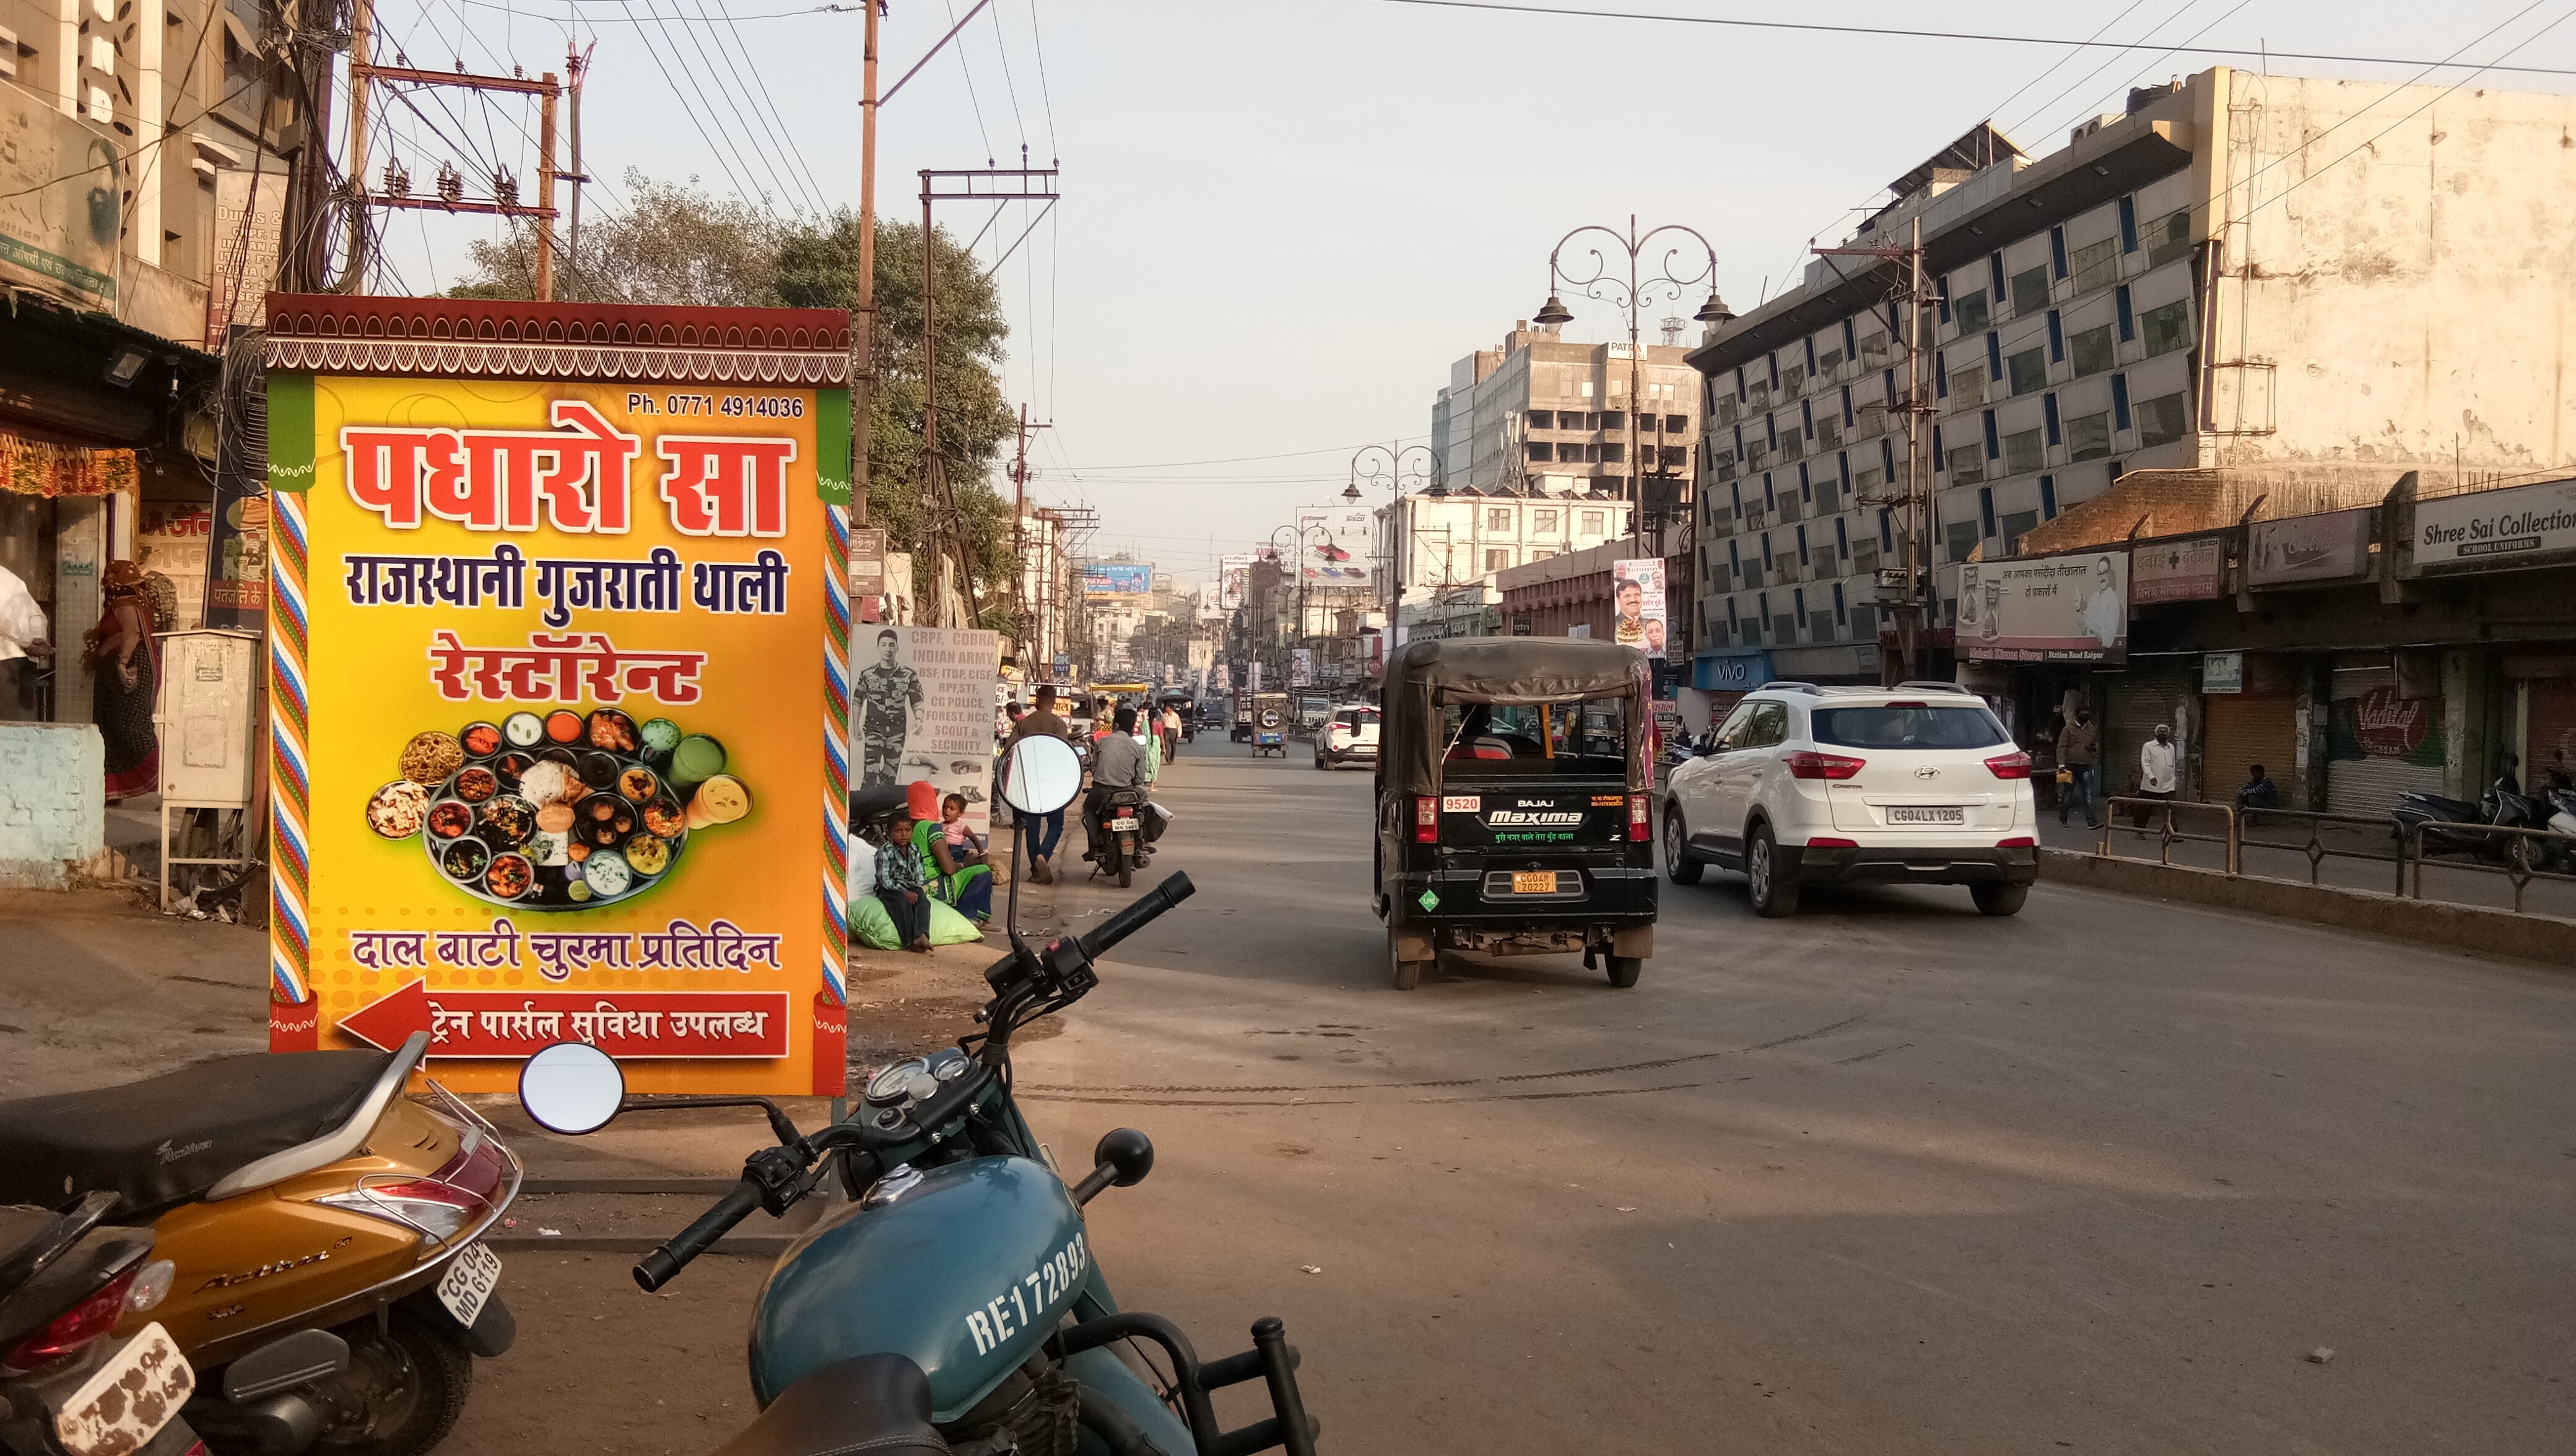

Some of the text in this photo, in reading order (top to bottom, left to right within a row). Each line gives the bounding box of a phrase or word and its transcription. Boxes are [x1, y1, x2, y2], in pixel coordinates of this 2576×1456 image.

[627, 392, 804, 418] Ph. 0771 4914036
[341, 400, 797, 537] पधारो सा
[2424, 524, 2465, 546] Shree
[2469, 518, 2494, 540] Sai
[2463, 538, 2535, 555] SCHOOL UNIFORMS
[2003, 564, 2087, 579] अब आपका पसंदीदा तीखालाल
[344, 544, 527, 609] राजस्थानी
[536, 545, 684, 629] गुजराती
[692, 548, 790, 615] थाली
[2025, 587, 2031, 598] दो
[2032, 584, 2051, 597] प्रकारों
[911, 630, 998, 648] CRPF, COBRA,
[913, 649, 994, 667] INDIAN ARMY,
[1054, 656, 1069, 665] GK
[2019, 649, 2043, 661] Stores
[2048, 651, 2068, 659] Station
[2069, 651, 2082, 659] Road
[2084, 651, 2104, 661] Raipur
[426, 629, 708, 704] रेस्टॉरेन्ट
[919, 667, 939, 680] BSF,
[1717, 659, 1746, 681] vivo
[931, 696, 985, 709] CG POLICE,
[926, 711, 991, 724] FOREST, NCC,
[934, 726, 978, 737] SCOUT &
[931, 740, 981, 751] SECURITY
[1446, 799, 1478, 809] 9520
[1488, 810, 1583, 826] Maxima
[1894, 808, 1962, 822] CG04LX1205
[1495, 832, 1507, 843] बुरी
[1535, 831, 1546, 841] तेरा
[1522, 883, 1550, 892] Z0227
[350, 917, 784, 982] दाल बाटी चुरमा प्रतिदिन
[427, 1000, 770, 1045] ट्रेन पार्सल सुविधा उपलब्ध
[446, 1266, 468, 1298] CG
[455, 1253, 498, 1323] MD 6119
[965, 1232, 1085, 1356] RE172893
